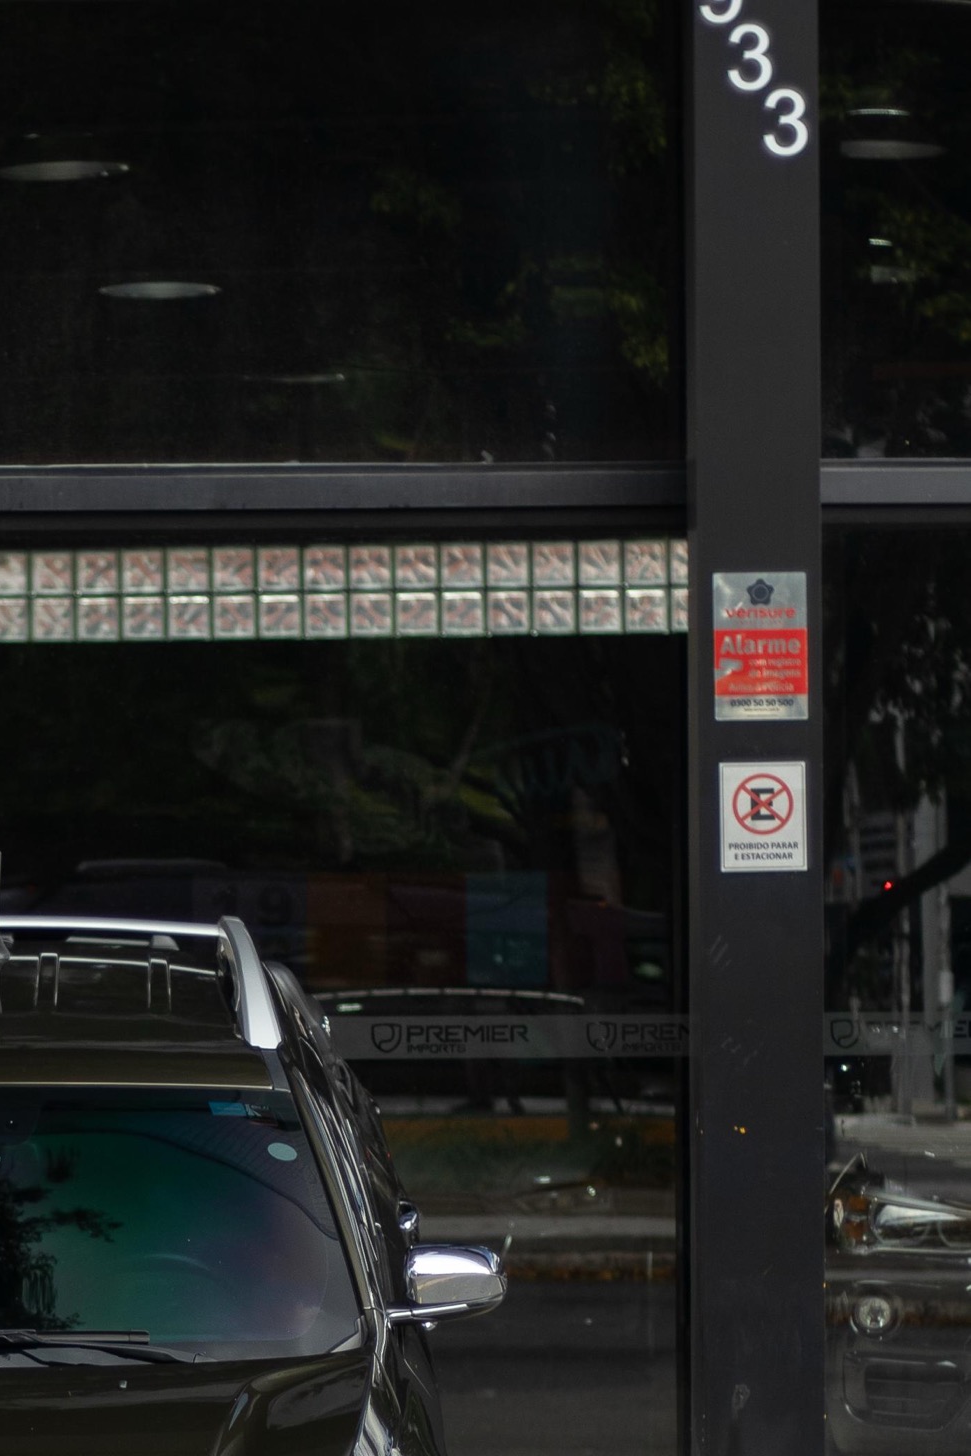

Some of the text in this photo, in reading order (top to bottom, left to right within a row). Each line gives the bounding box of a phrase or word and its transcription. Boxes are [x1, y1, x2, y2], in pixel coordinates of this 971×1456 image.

[721, 635, 801, 655] Alarme
[728, 841, 799, 850] PROIBIDO PARAR
[741, 852, 793, 860] ESTACIONAR
[406, 1025, 529, 1043] PREMIER
[406, 1043, 467, 1054] IMPORTS
